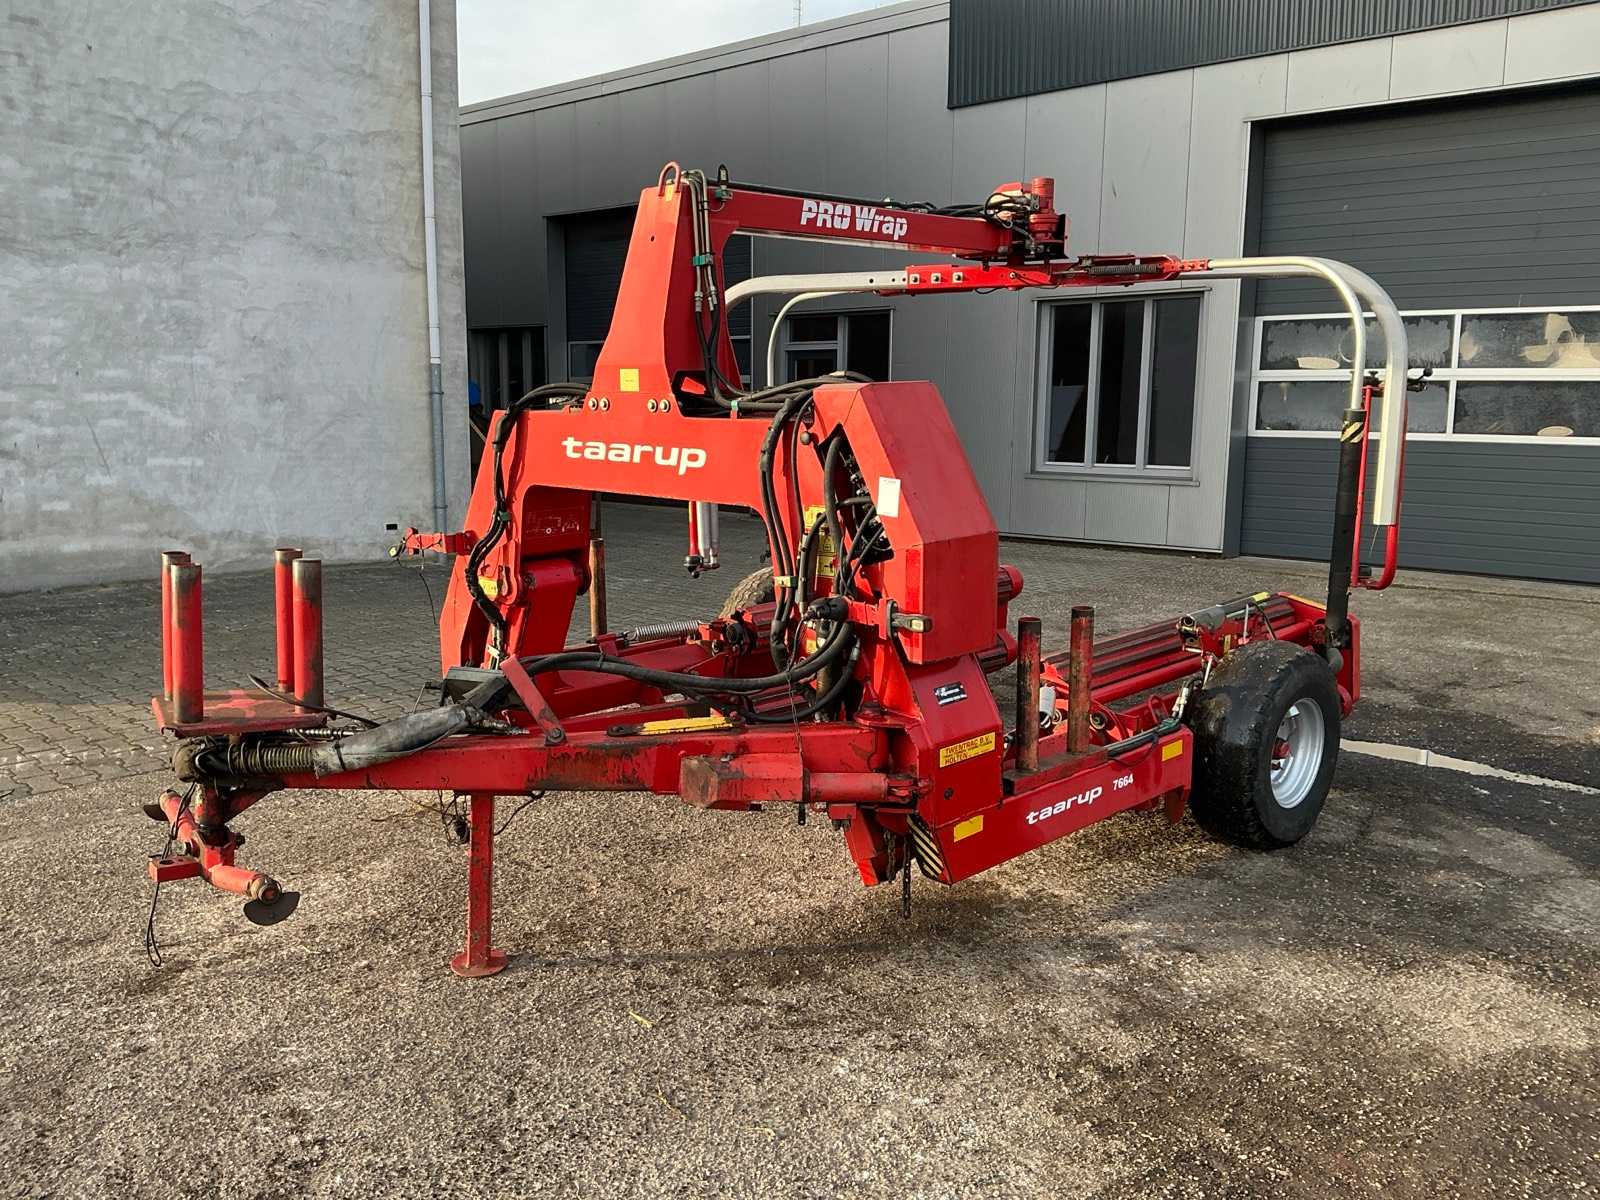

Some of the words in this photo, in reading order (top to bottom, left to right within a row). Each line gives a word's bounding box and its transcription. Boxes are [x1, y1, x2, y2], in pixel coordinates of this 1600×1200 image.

[800, 199, 852, 230] PRO
[855, 205, 908, 241] Wrap
[561, 436, 707, 476] taarup
[1026, 786, 1103, 825] taarup
[1113, 773, 1134, 791] 7664
